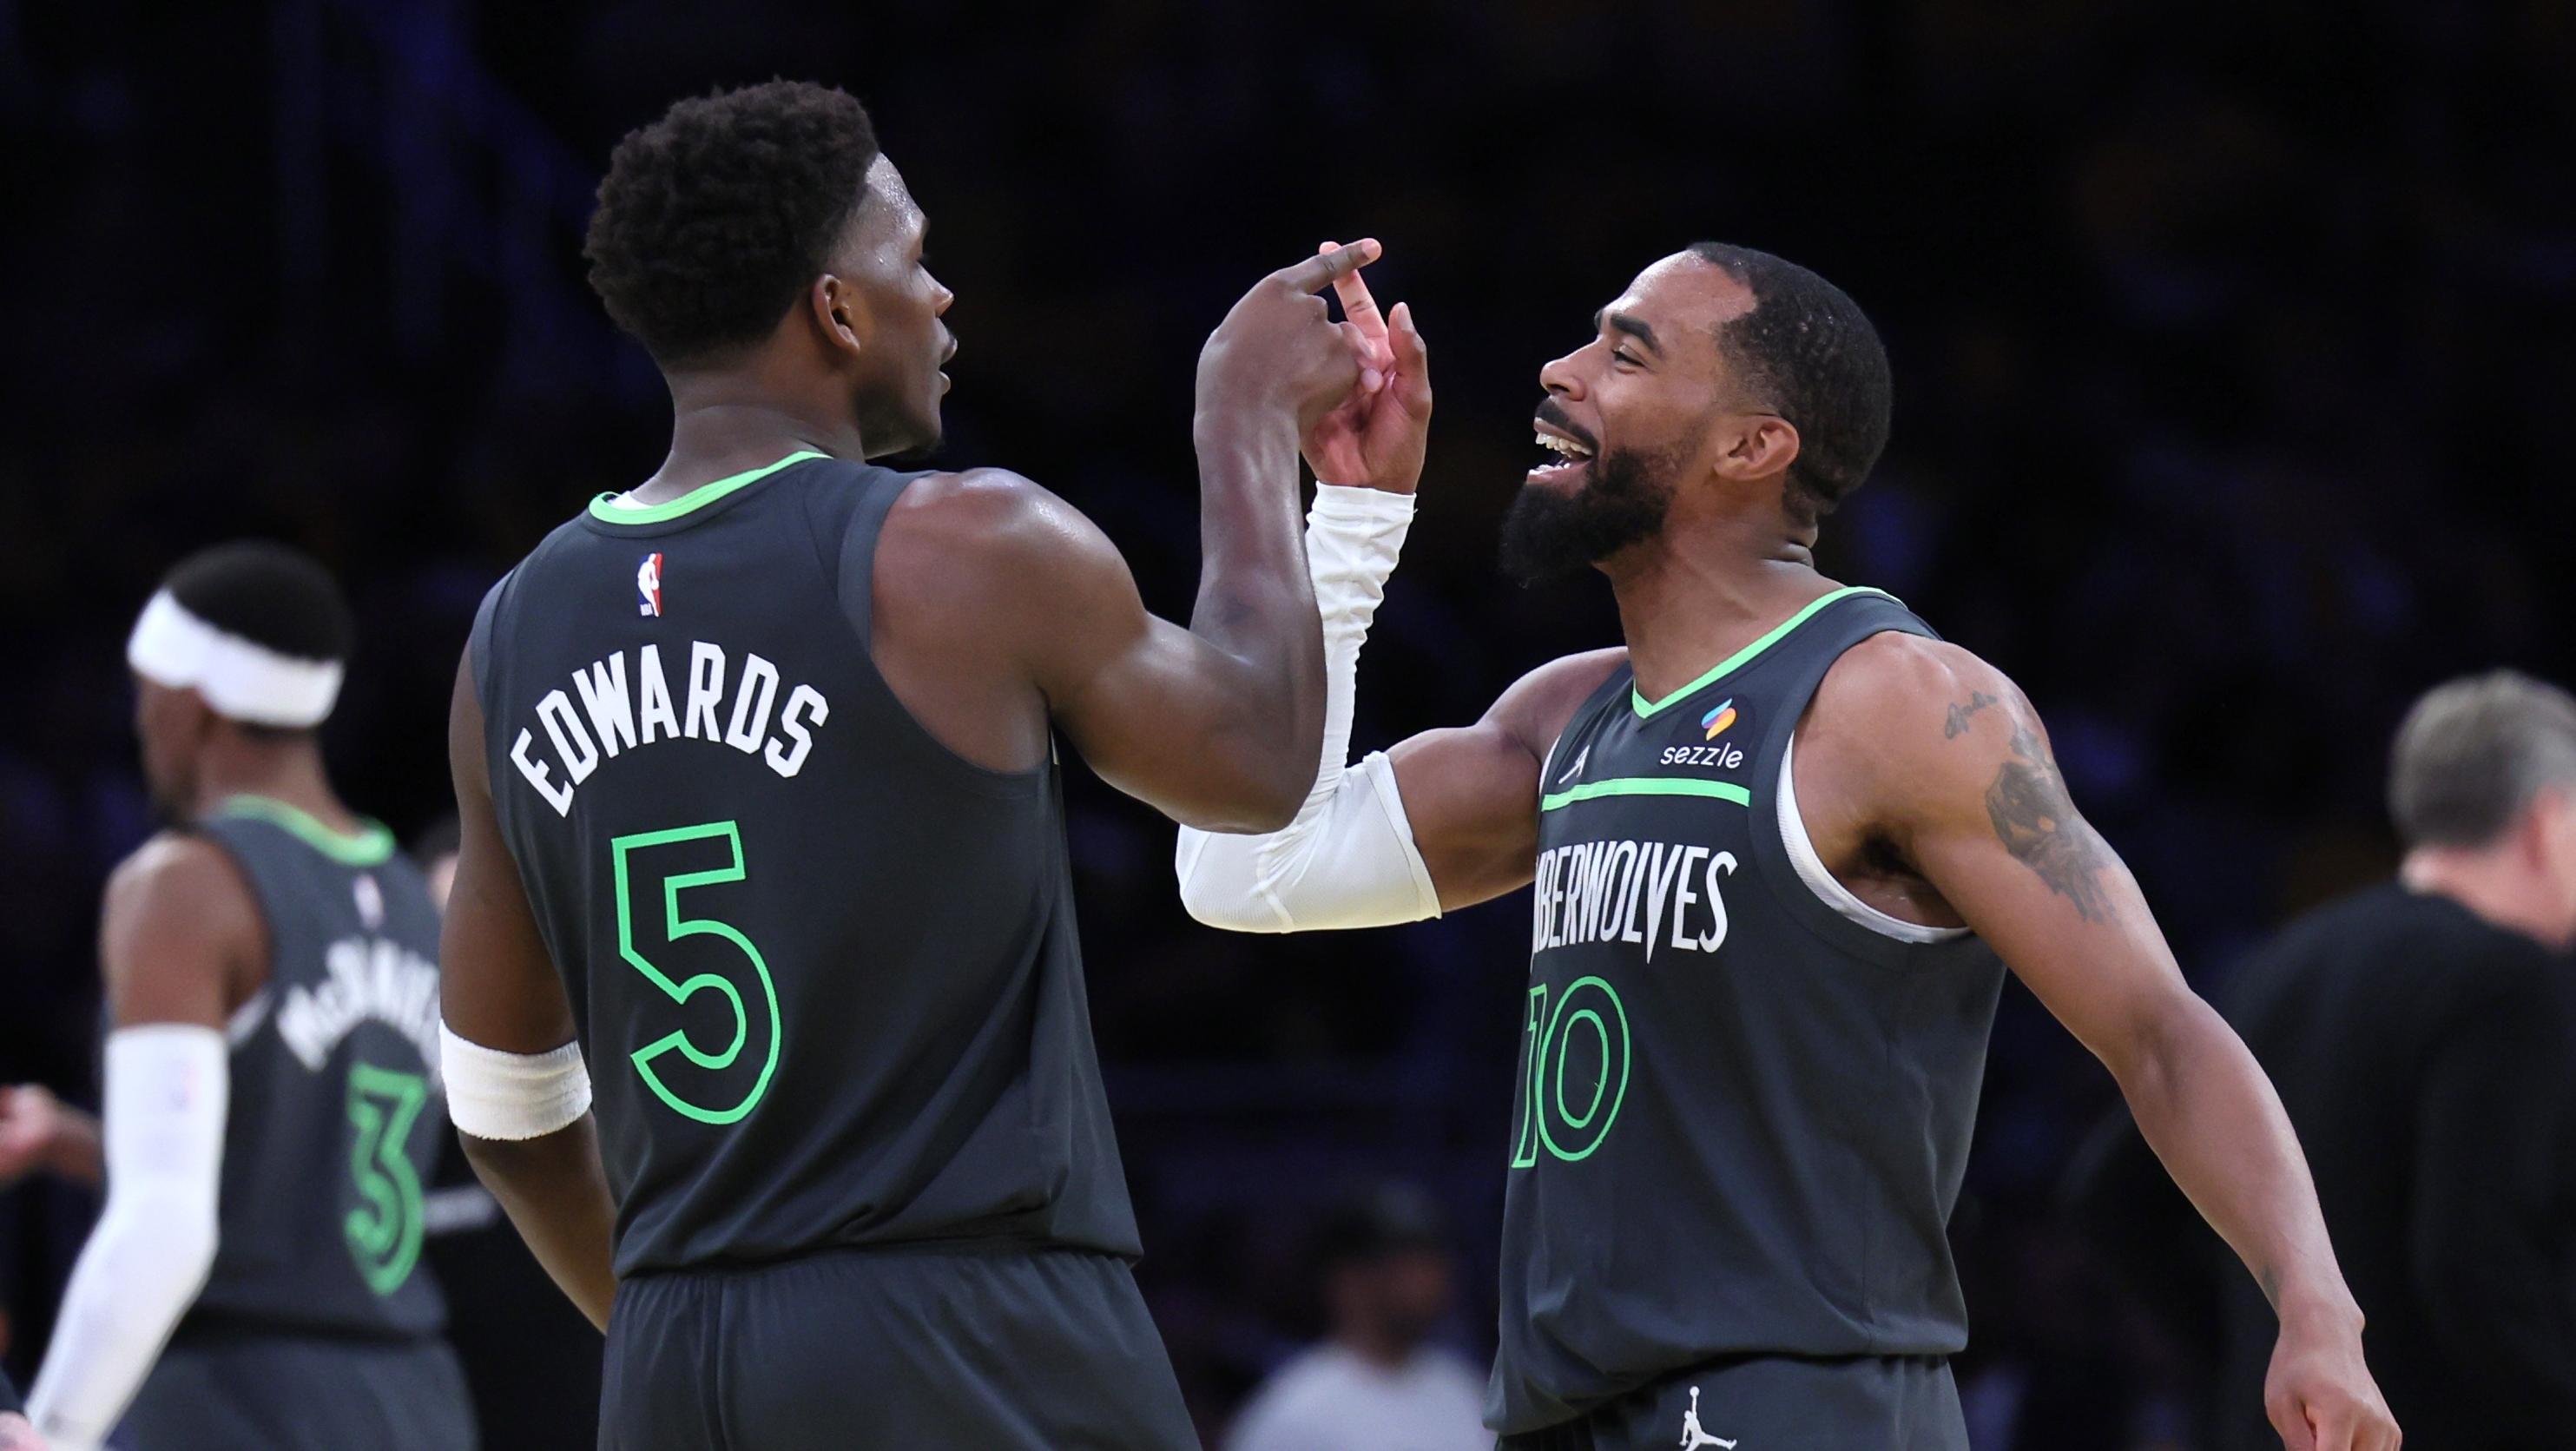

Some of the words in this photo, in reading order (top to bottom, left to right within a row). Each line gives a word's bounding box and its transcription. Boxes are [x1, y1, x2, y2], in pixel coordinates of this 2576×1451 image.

[510, 640, 829, 818] EDWARDS
[1660, 742, 1743, 769] sezzle
[610, 819, 782, 1125] 5
[1512, 975, 1631, 1169] 10
[346, 1063, 427, 1296] 3
